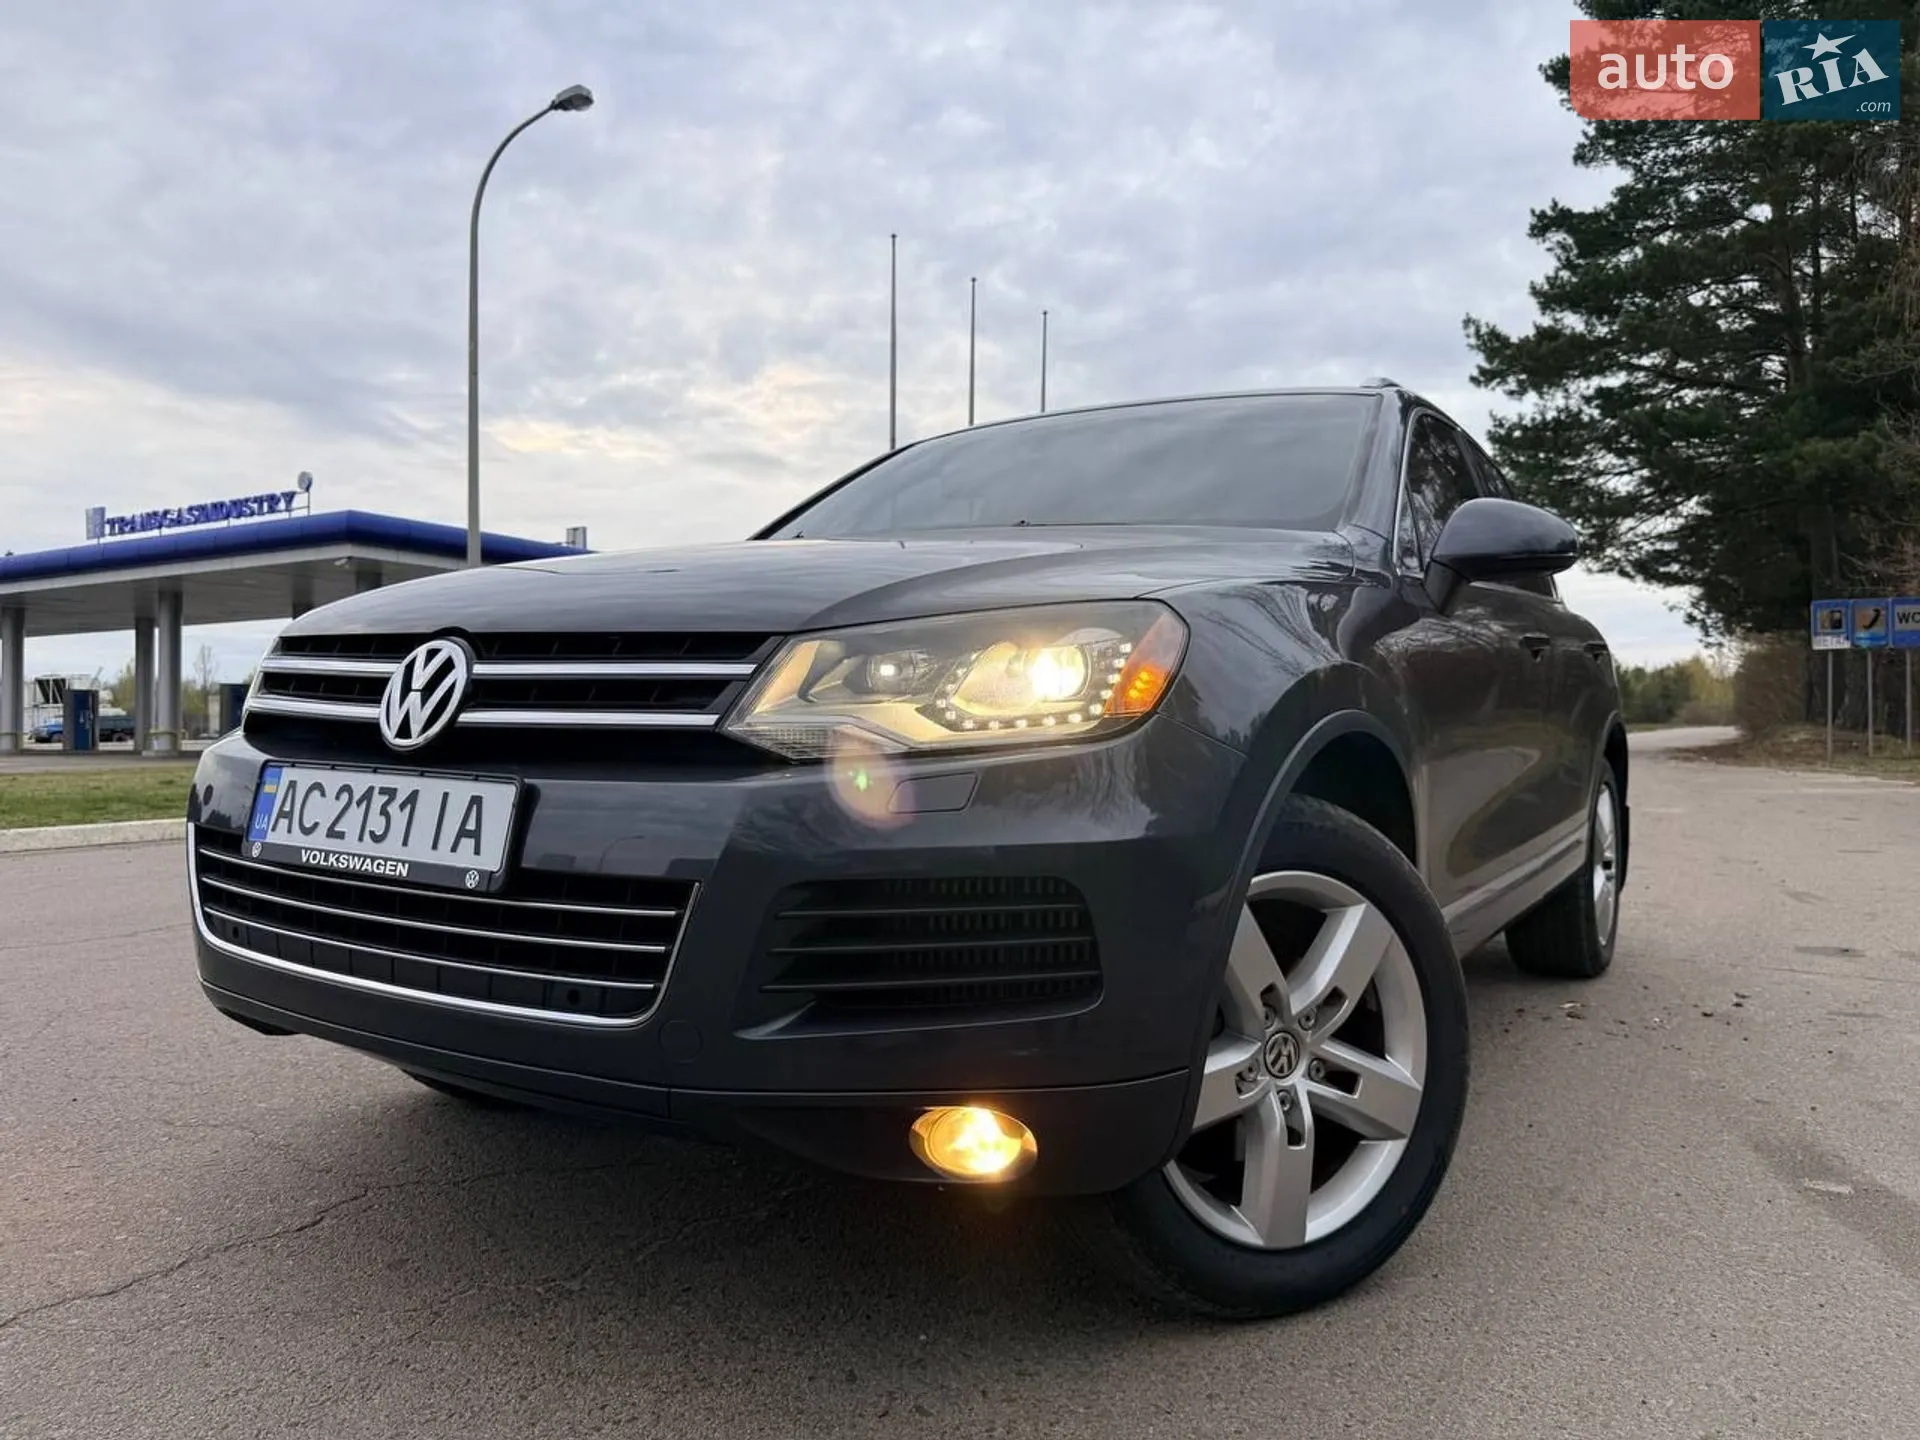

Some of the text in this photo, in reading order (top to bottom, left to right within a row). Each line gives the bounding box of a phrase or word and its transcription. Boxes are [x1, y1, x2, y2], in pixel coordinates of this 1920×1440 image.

[1897, 611, 1920, 625] WC
[255, 813, 268, 830] UA
[301, 849, 409, 877] VOLKSWAGEN
